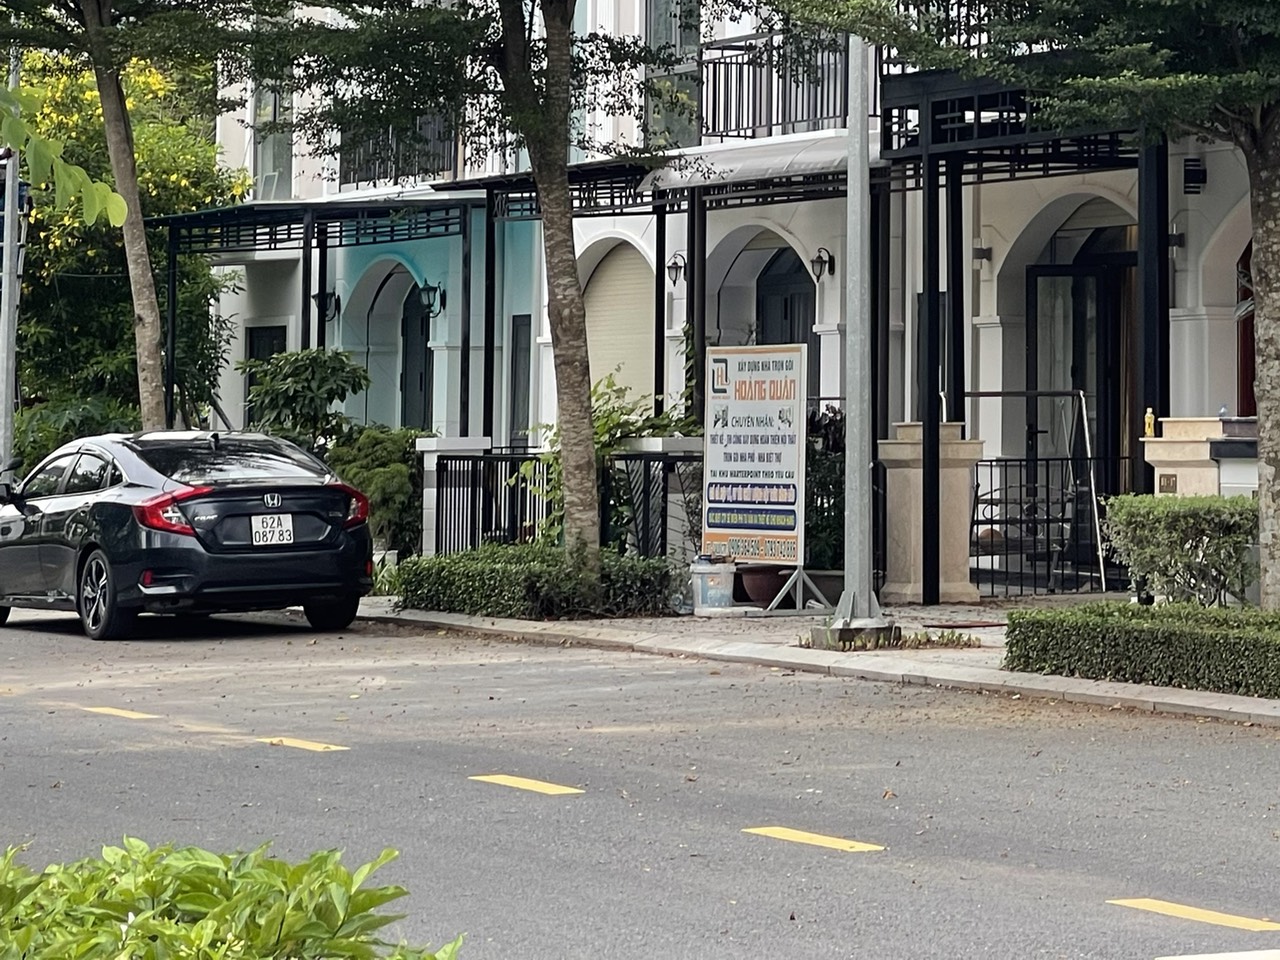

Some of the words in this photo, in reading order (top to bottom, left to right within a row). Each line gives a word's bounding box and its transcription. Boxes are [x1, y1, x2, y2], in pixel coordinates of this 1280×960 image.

[735, 376, 766, 400] HOÀNG
[769, 375, 796, 400] QUÂN
[731, 413, 755, 428] CHUYÊN
[261, 516, 283, 529] 62A
[254, 530, 292, 544] 087.83
